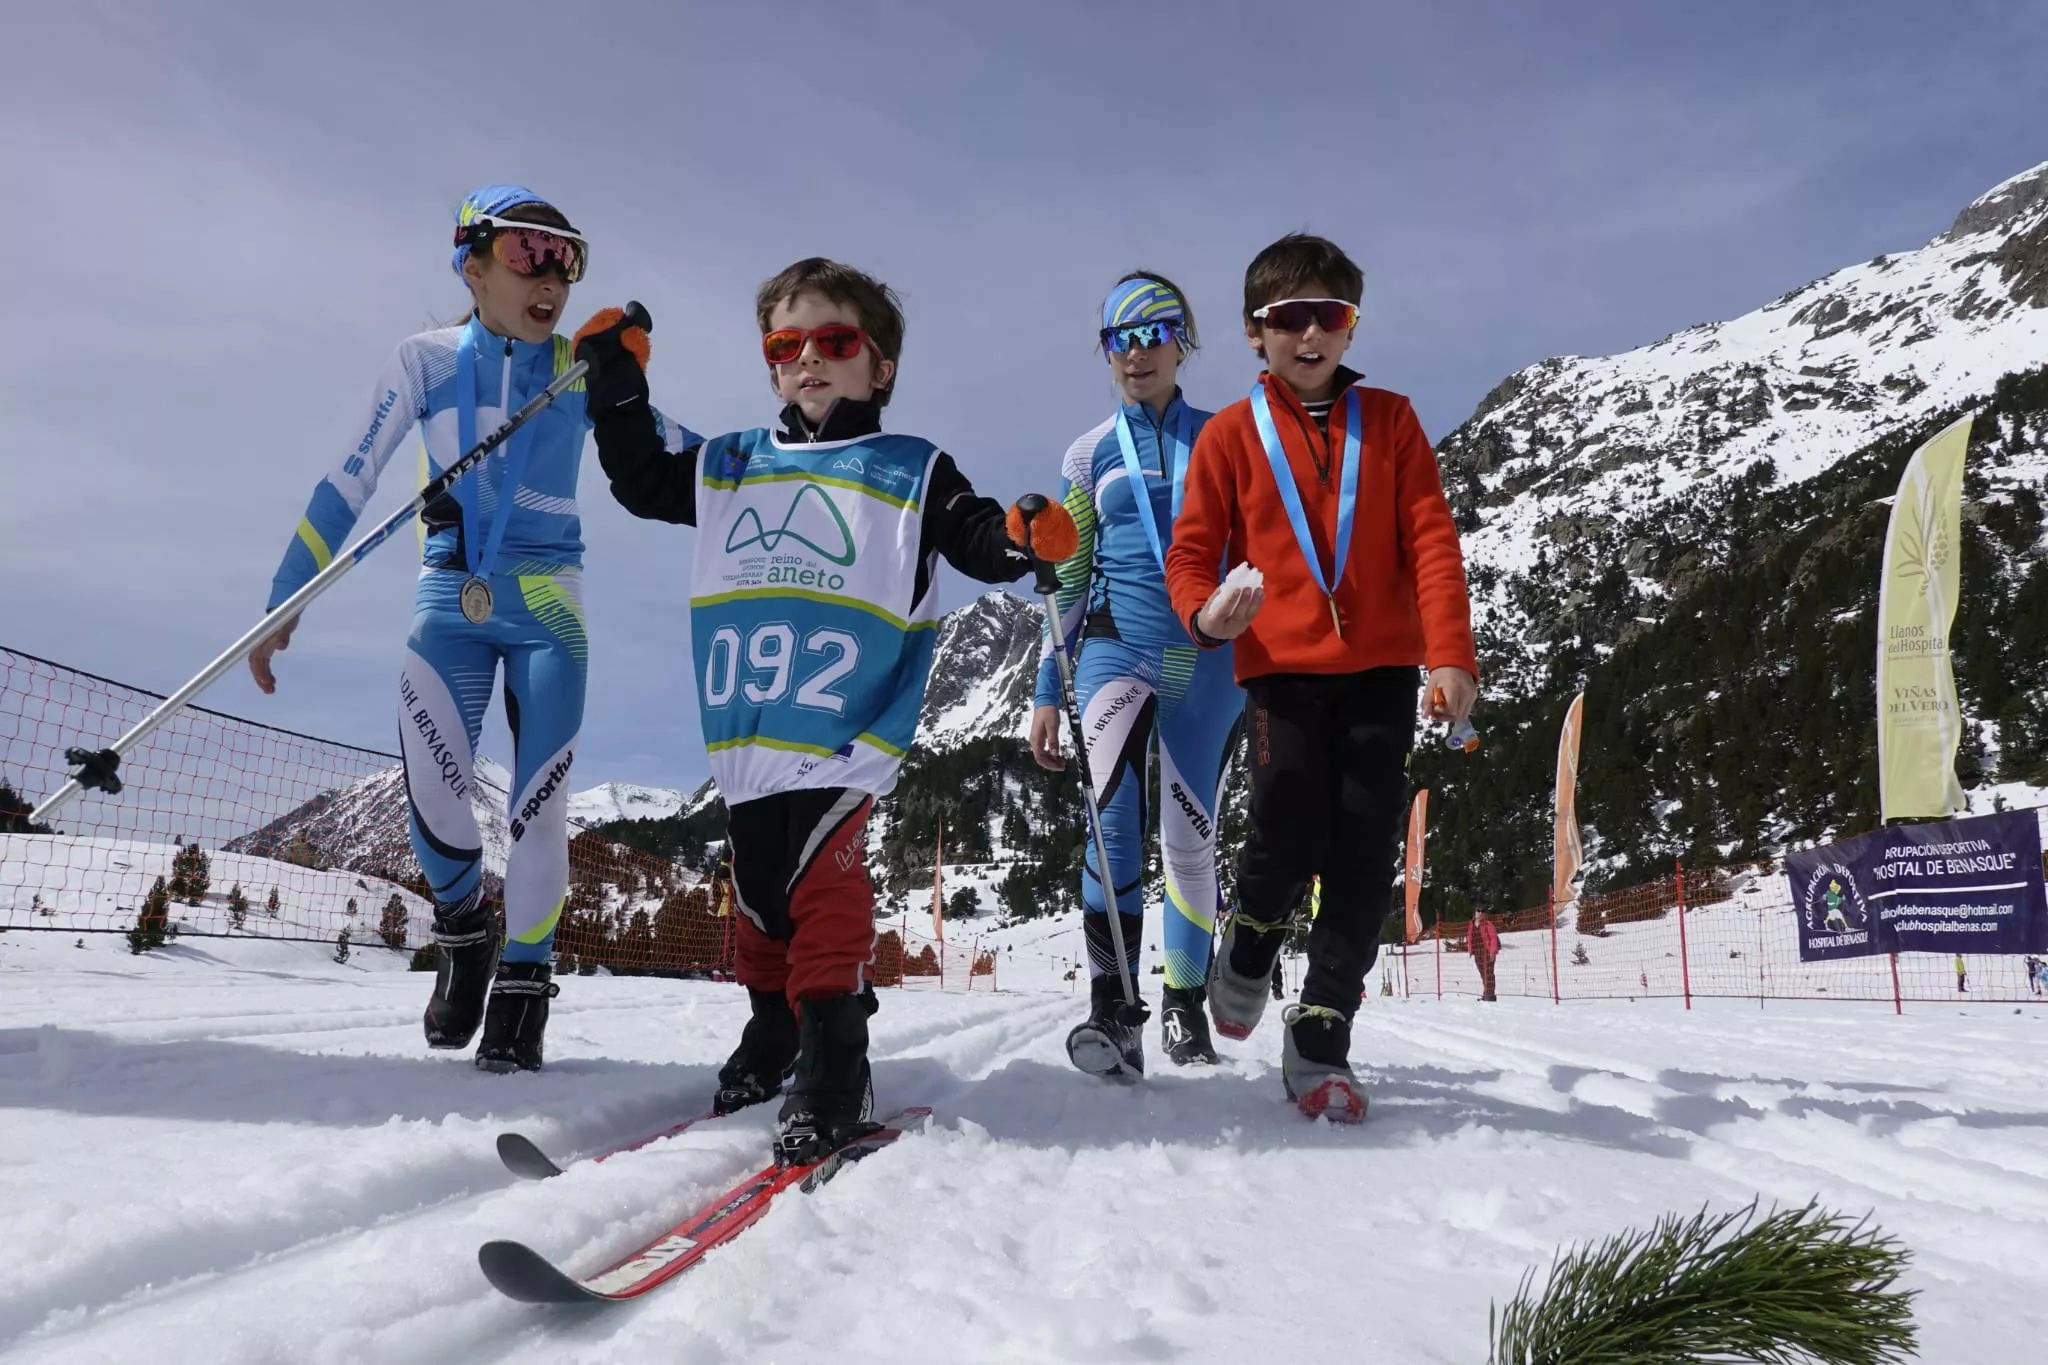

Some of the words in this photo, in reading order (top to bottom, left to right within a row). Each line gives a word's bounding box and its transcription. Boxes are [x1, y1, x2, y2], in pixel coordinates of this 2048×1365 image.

[358, 389, 398, 455] sportful
[766, 564, 845, 591] aneto
[770, 553, 803, 566] reino
[1890, 625, 1924, 639] Llanos
[705, 620, 862, 719] 092
[1895, 685, 1937, 699] VIÑAS
[1064, 679, 1081, 724] LEKI
[1094, 685, 1142, 731] BENASQUE
[413, 709, 468, 800] BENASQUE
[522, 750, 574, 822] sportful
[1170, 781, 1213, 841] sportful
[1926, 860, 1945, 876] DE
